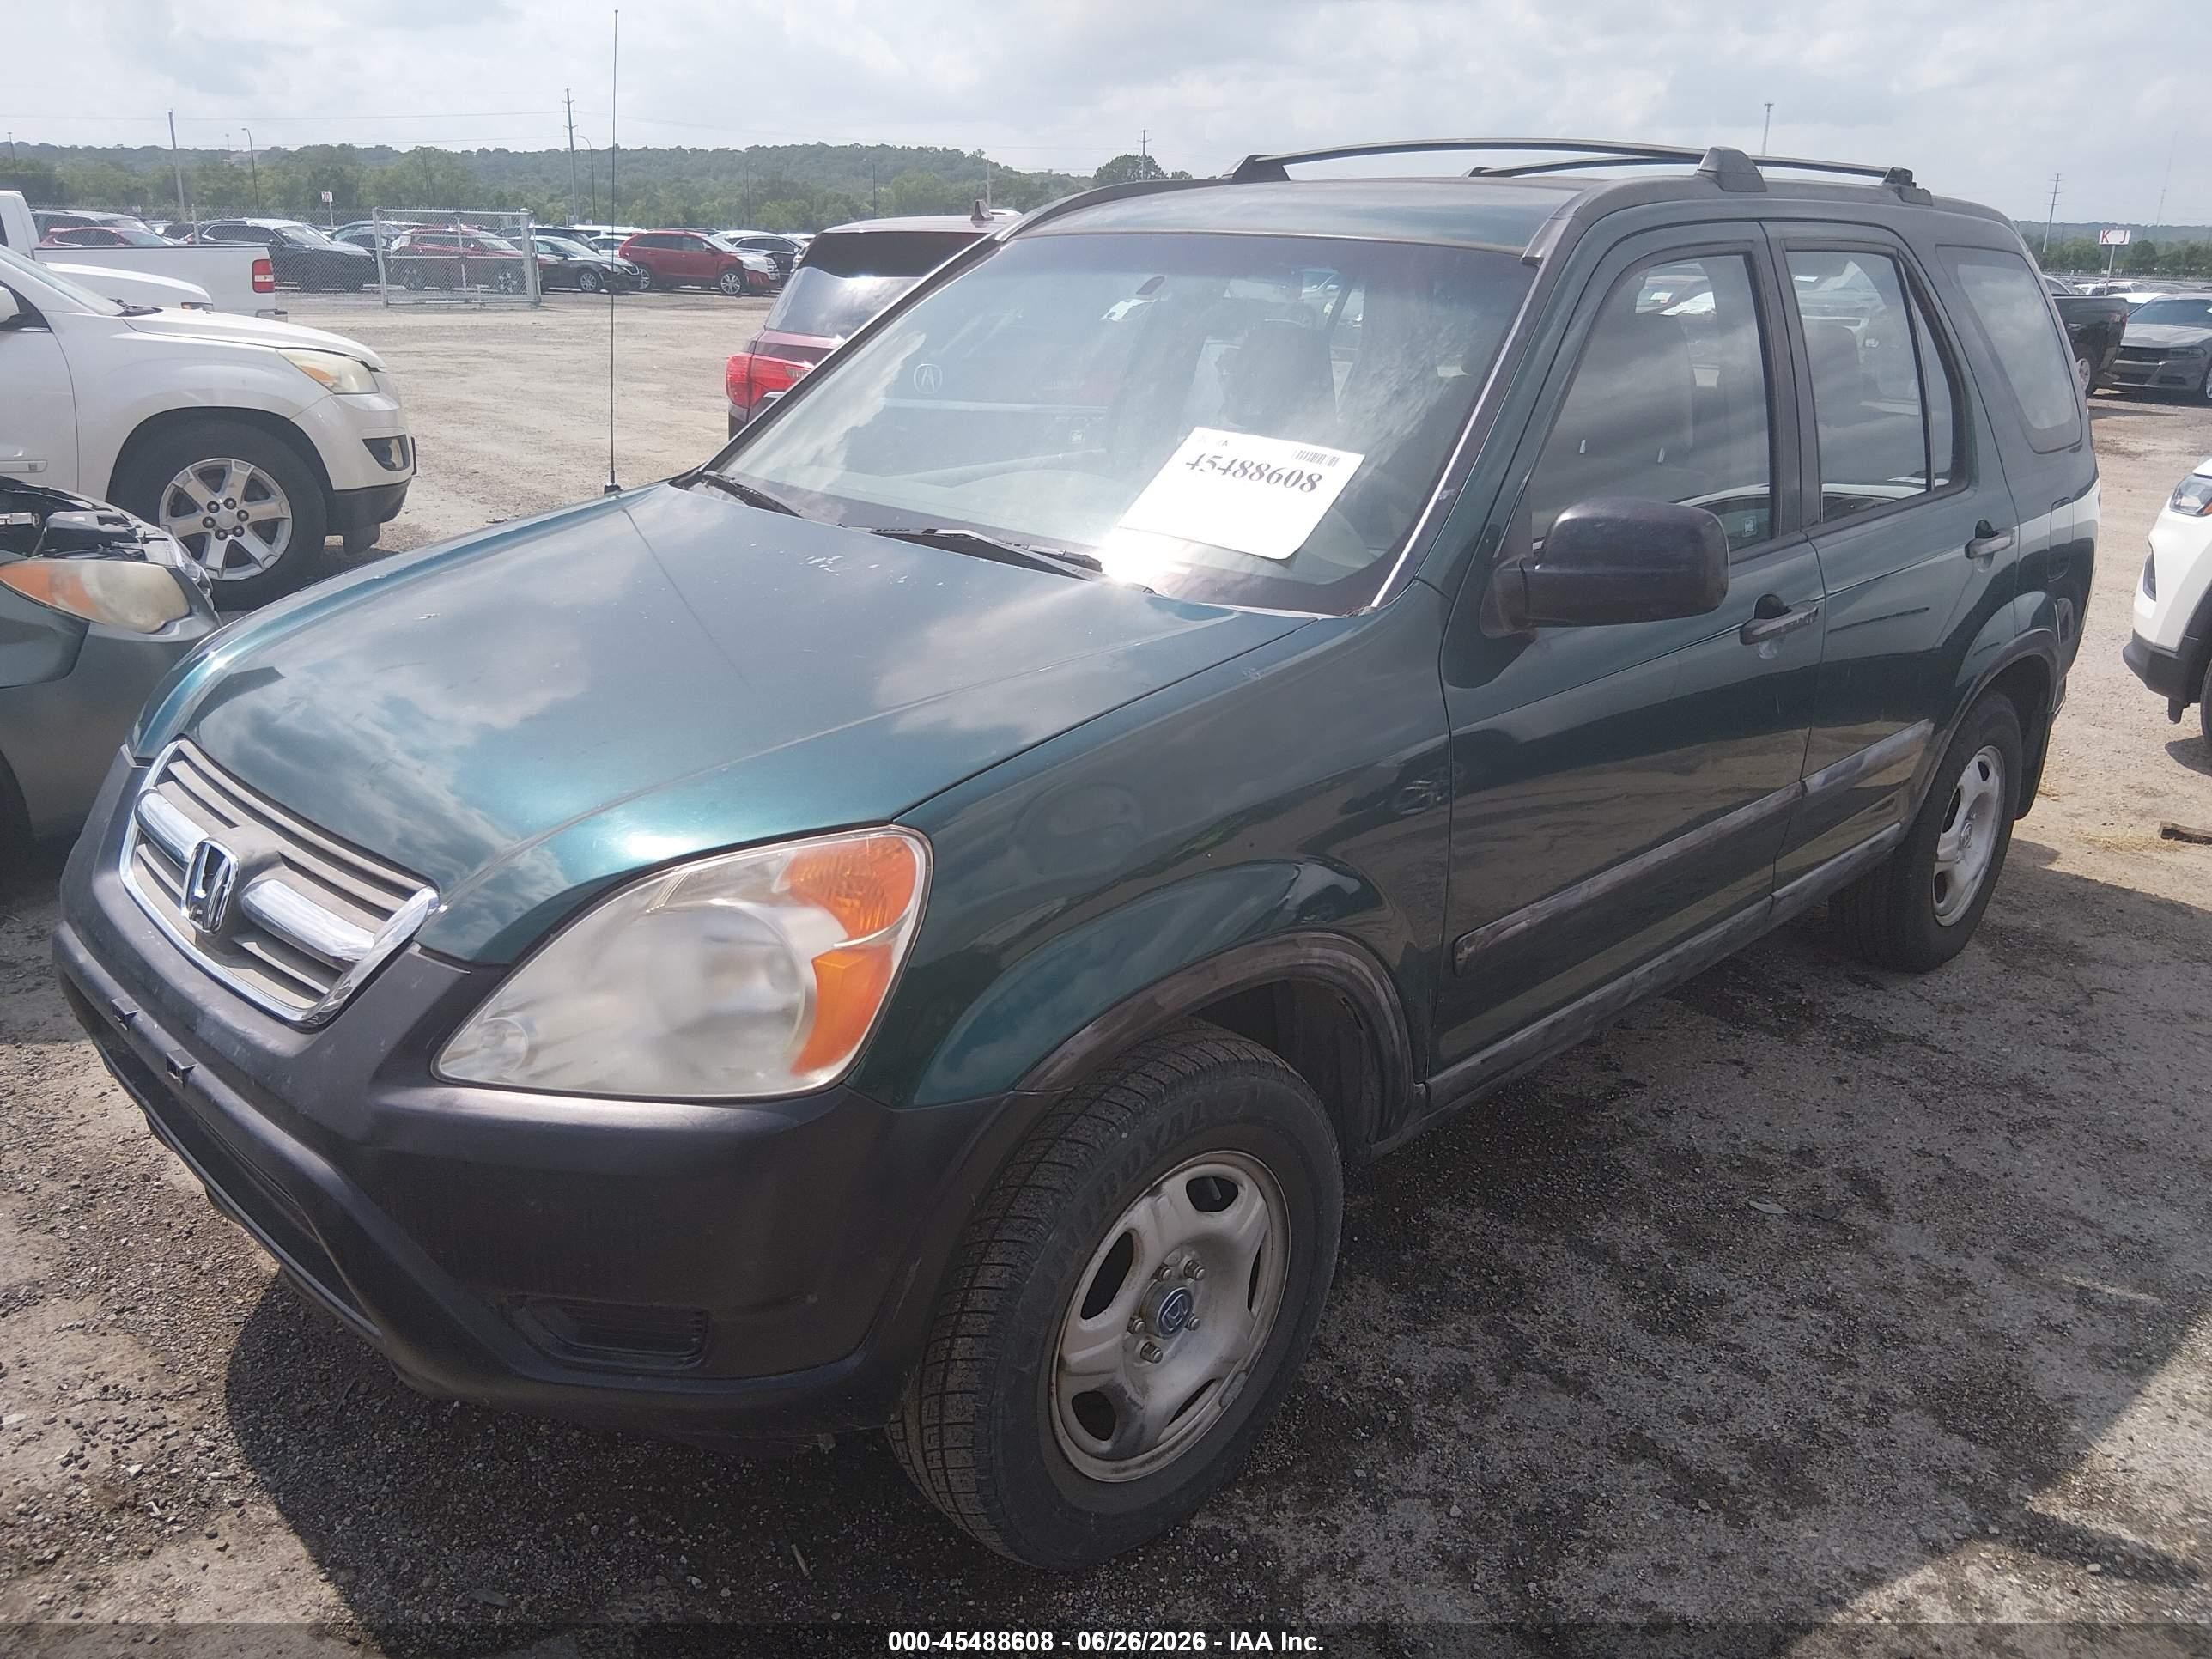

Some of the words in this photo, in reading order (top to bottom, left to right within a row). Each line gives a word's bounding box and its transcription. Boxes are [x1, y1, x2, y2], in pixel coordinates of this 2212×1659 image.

[2100, 229, 2111, 244] K
[2119, 230, 2128, 244] J
[1185, 453, 1323, 493] 45488608
